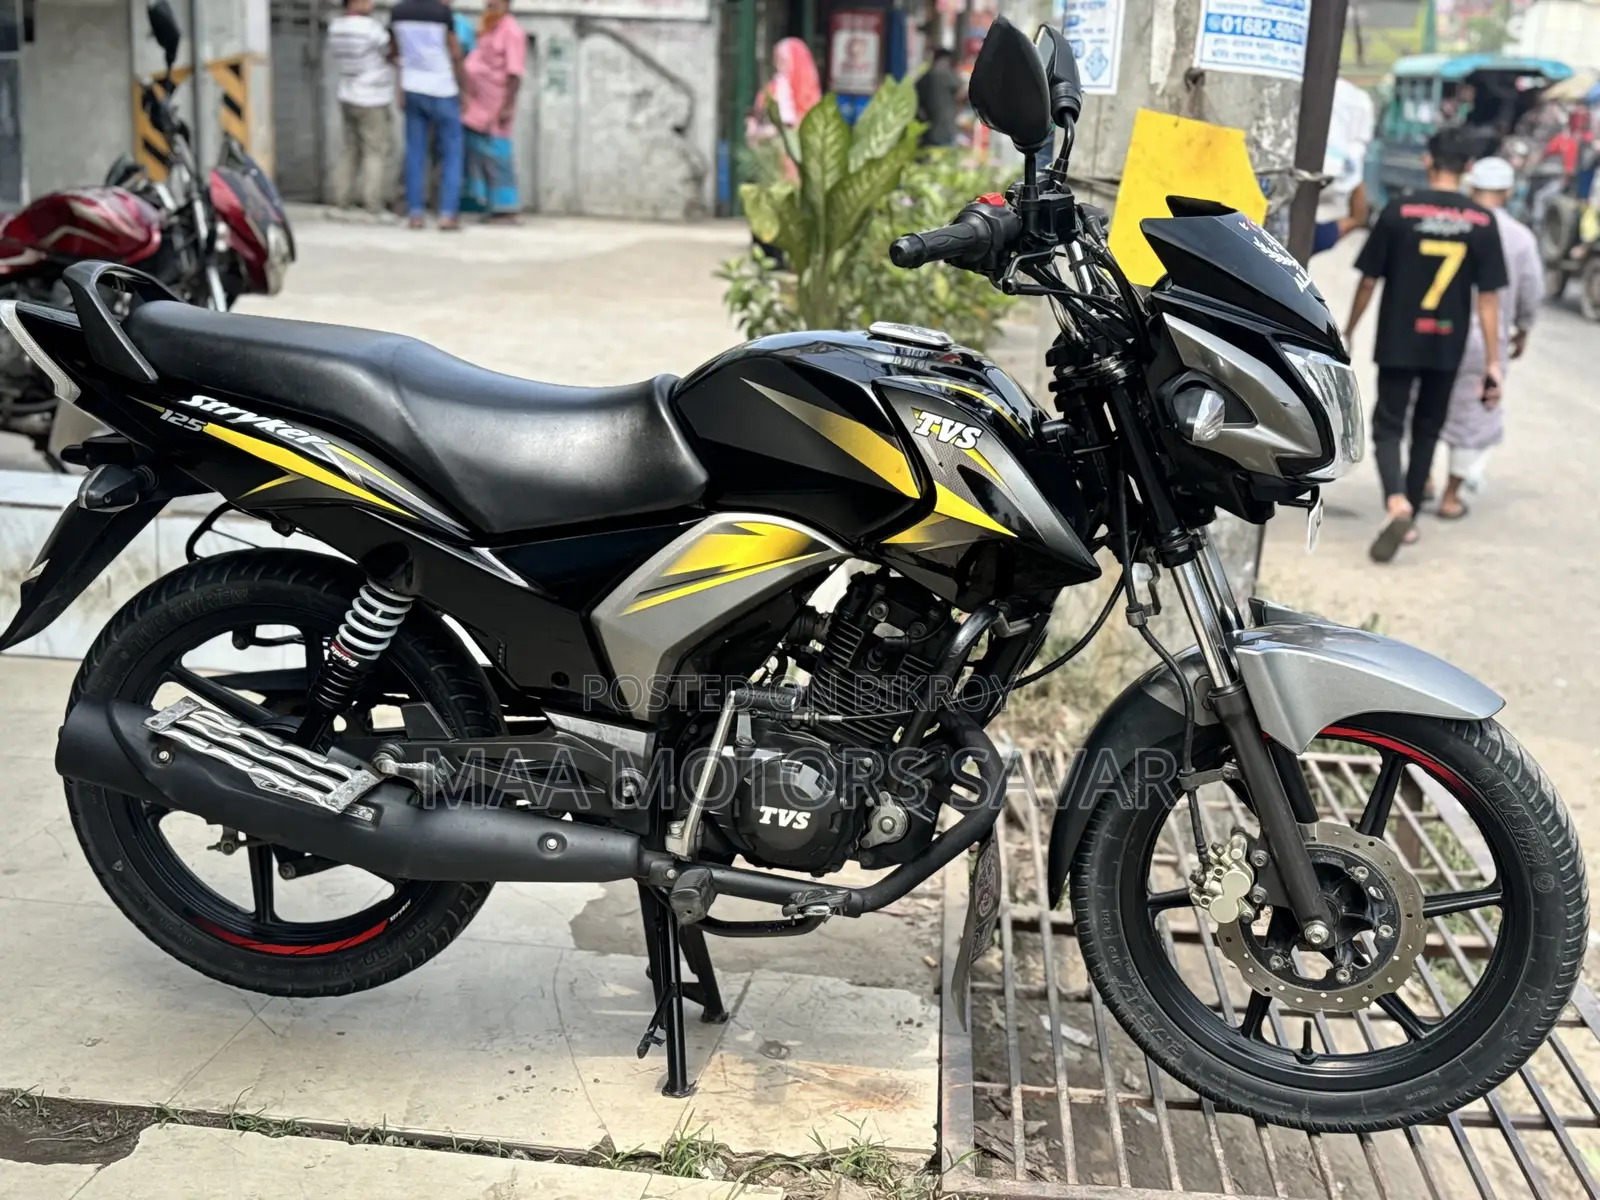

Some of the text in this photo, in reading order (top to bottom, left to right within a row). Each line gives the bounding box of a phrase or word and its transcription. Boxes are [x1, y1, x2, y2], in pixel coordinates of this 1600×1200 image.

[1419, 239, 1467, 310] 7
[160, 409, 208, 432] 125
[178, 395, 330, 445] Stryker
[913, 411, 984, 449] TVS
[758, 805, 811, 830] TVS
